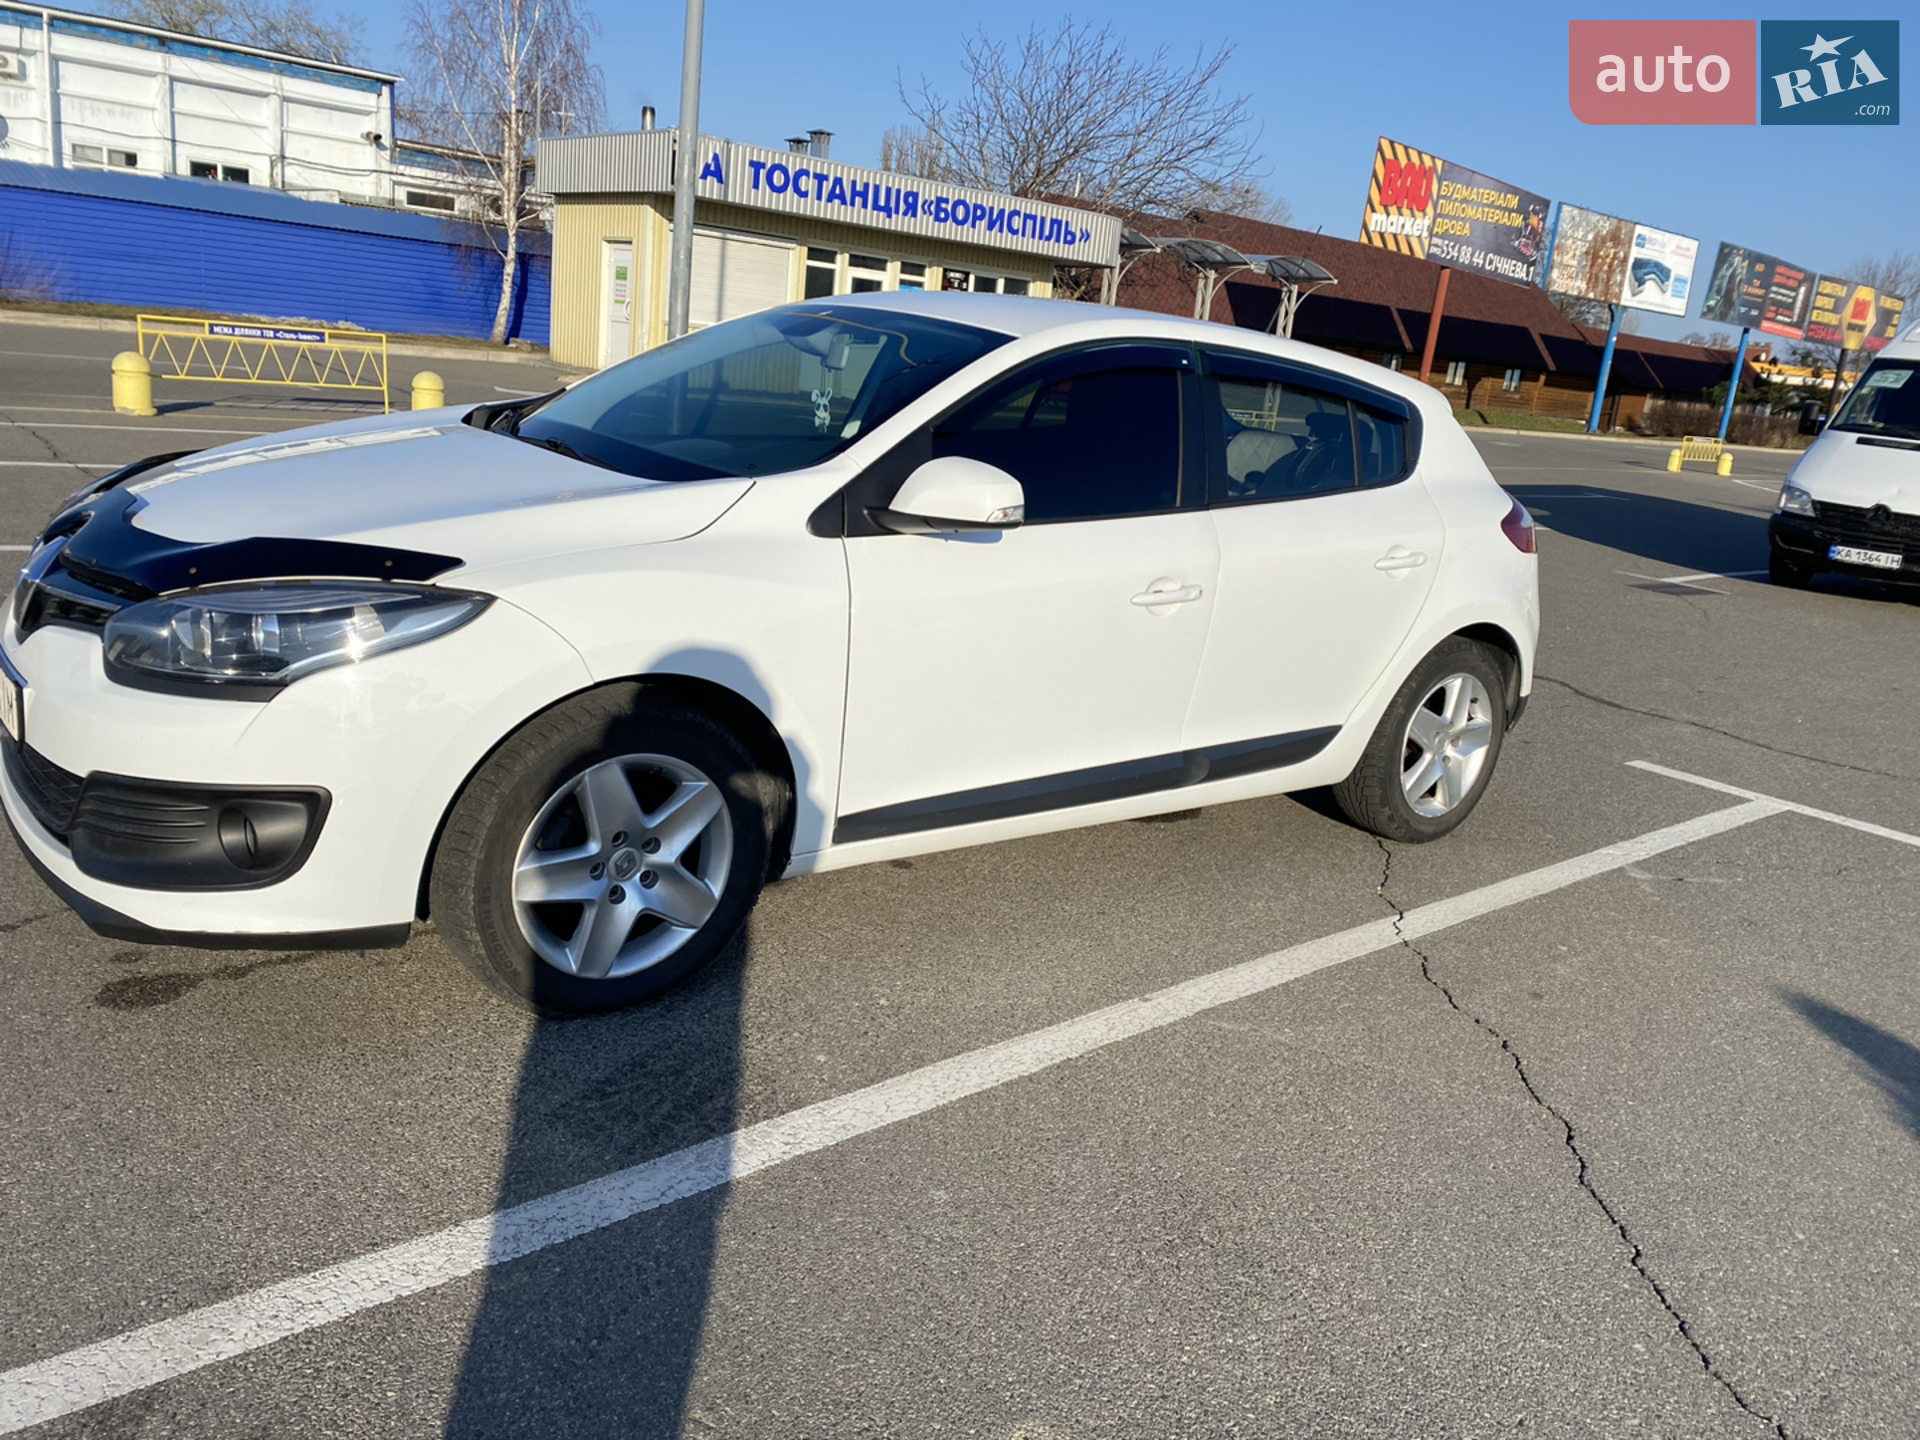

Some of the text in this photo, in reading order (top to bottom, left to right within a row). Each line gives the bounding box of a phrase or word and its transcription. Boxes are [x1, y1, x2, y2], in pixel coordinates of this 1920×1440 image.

[1380, 158, 1435, 213] BAU
[1440, 181, 1519, 210] БУДМАТЕРІАЛИ
[1370, 212, 1430, 238] market
[1437, 199, 1524, 228] ПИЛОМАТЕРІАЛИ
[1433, 218, 1470, 237] ДРОВА
[1459, 245, 1473, 265] 88
[1472, 249, 1485, 268] 44
[1836, 547, 1852, 559] KA
[1856, 550, 1882, 563] 1364
